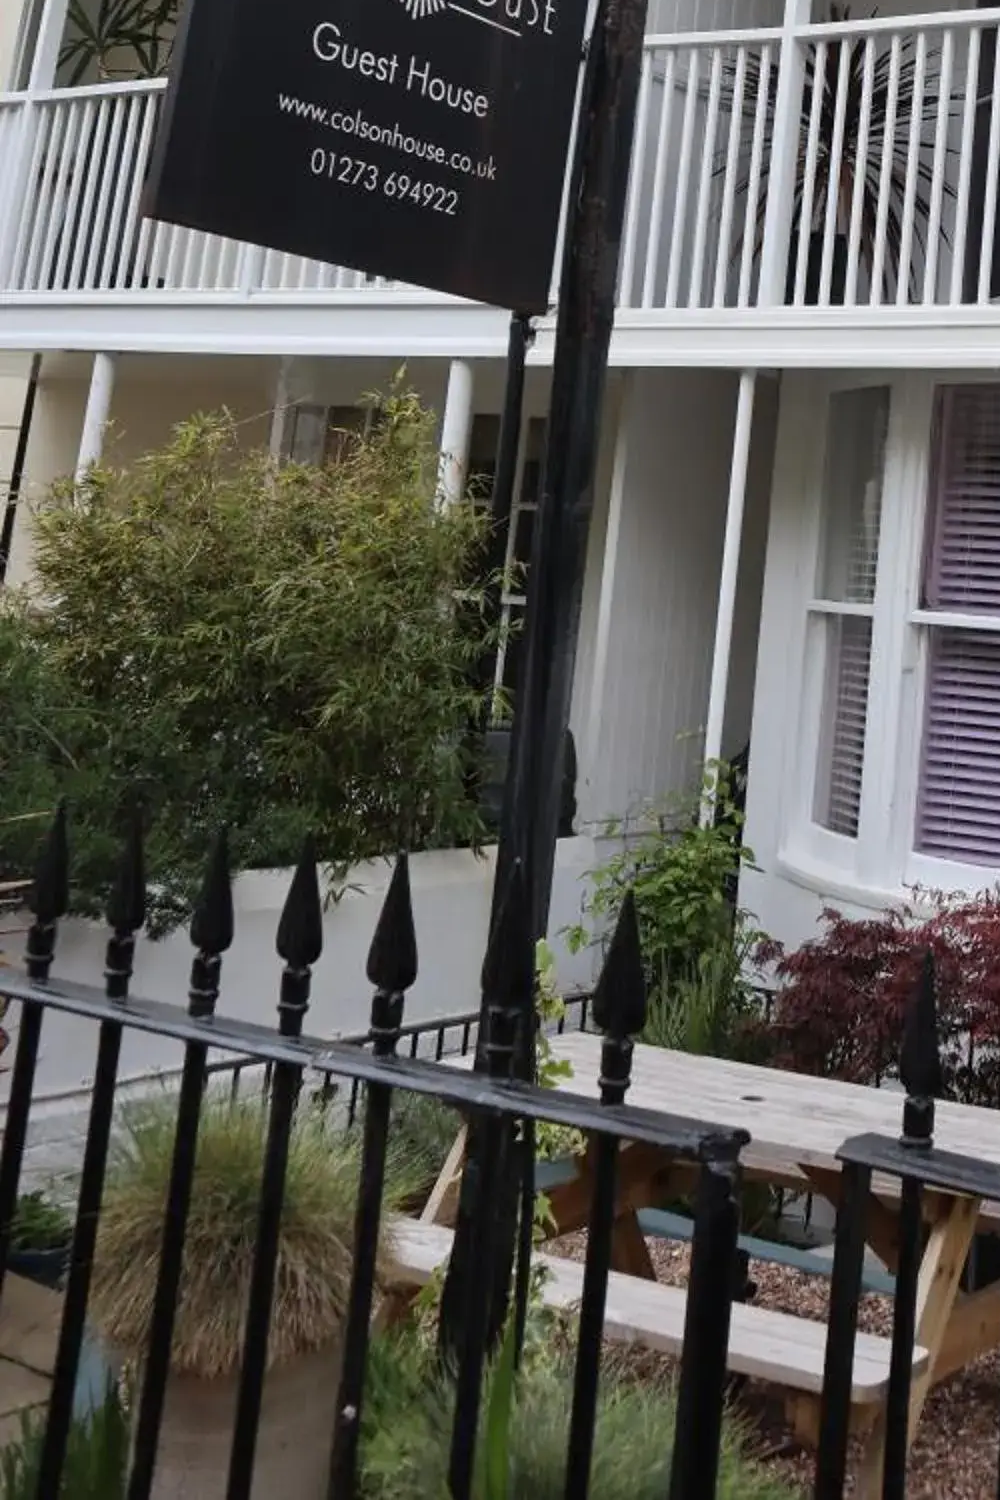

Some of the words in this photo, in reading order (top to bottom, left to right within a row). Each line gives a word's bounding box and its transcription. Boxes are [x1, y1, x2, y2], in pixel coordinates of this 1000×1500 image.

[312, 22, 398, 84] Guest
[406, 56, 490, 118] House
[278, 93, 497, 180] www.colsonhouse.co.uk
[310, 147, 378, 191] 01273
[383, 172, 458, 215] 694922
